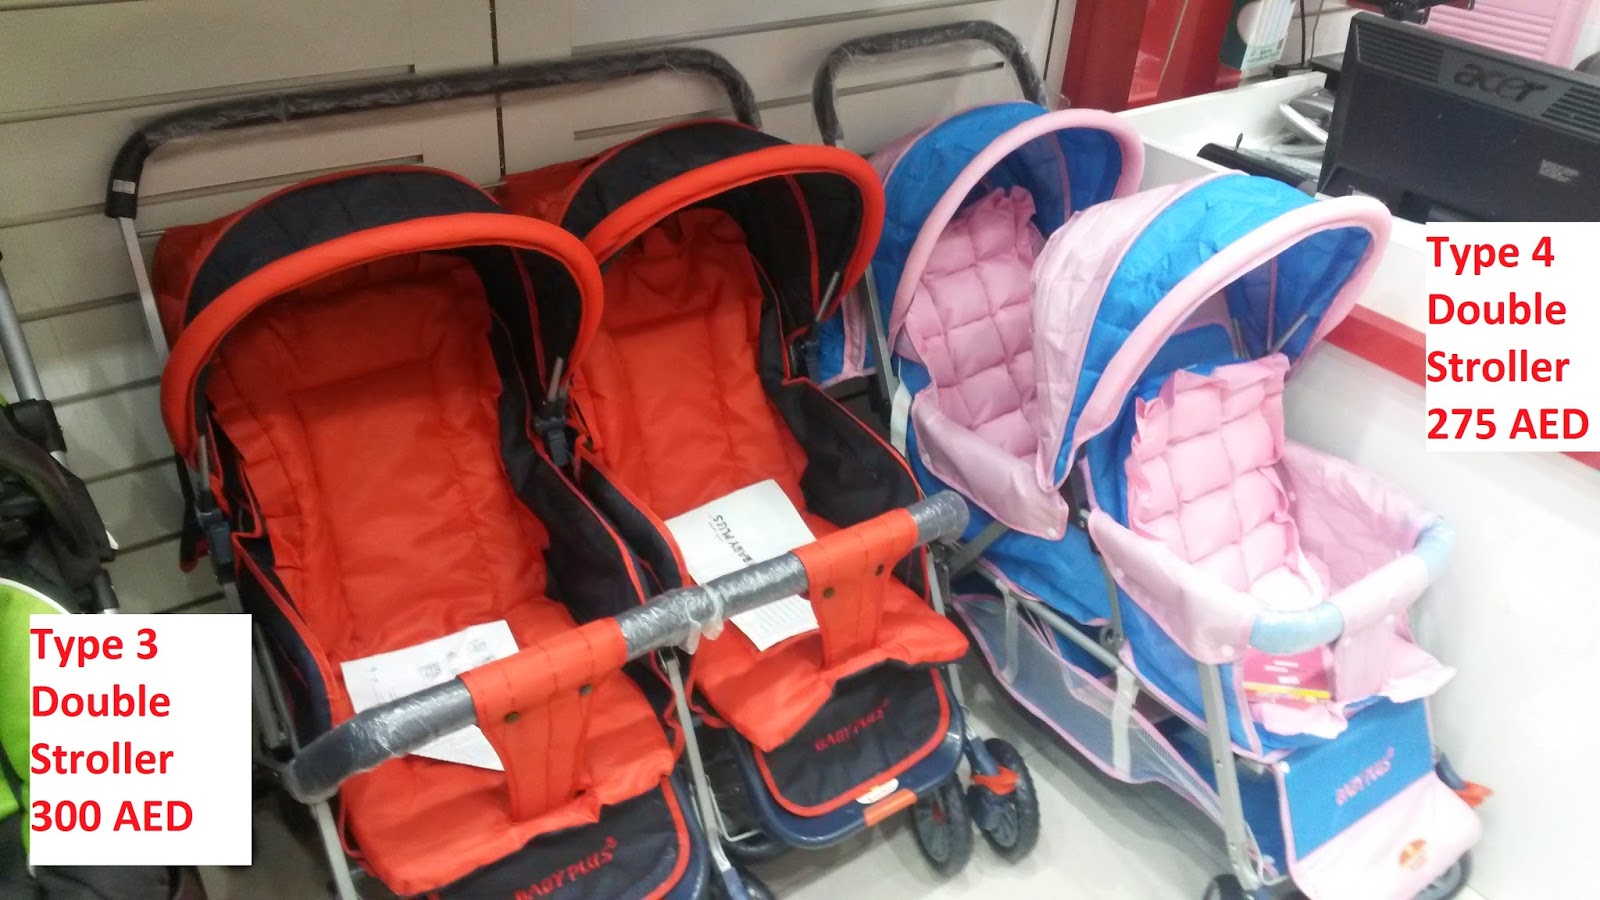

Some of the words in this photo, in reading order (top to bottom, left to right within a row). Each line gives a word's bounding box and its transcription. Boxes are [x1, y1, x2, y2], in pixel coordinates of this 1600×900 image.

[1453, 62, 1549, 102] acer
[713, 514, 735, 540] PLUS
[814, 723, 852, 752] BABY
[514, 869, 564, 900] BABY
